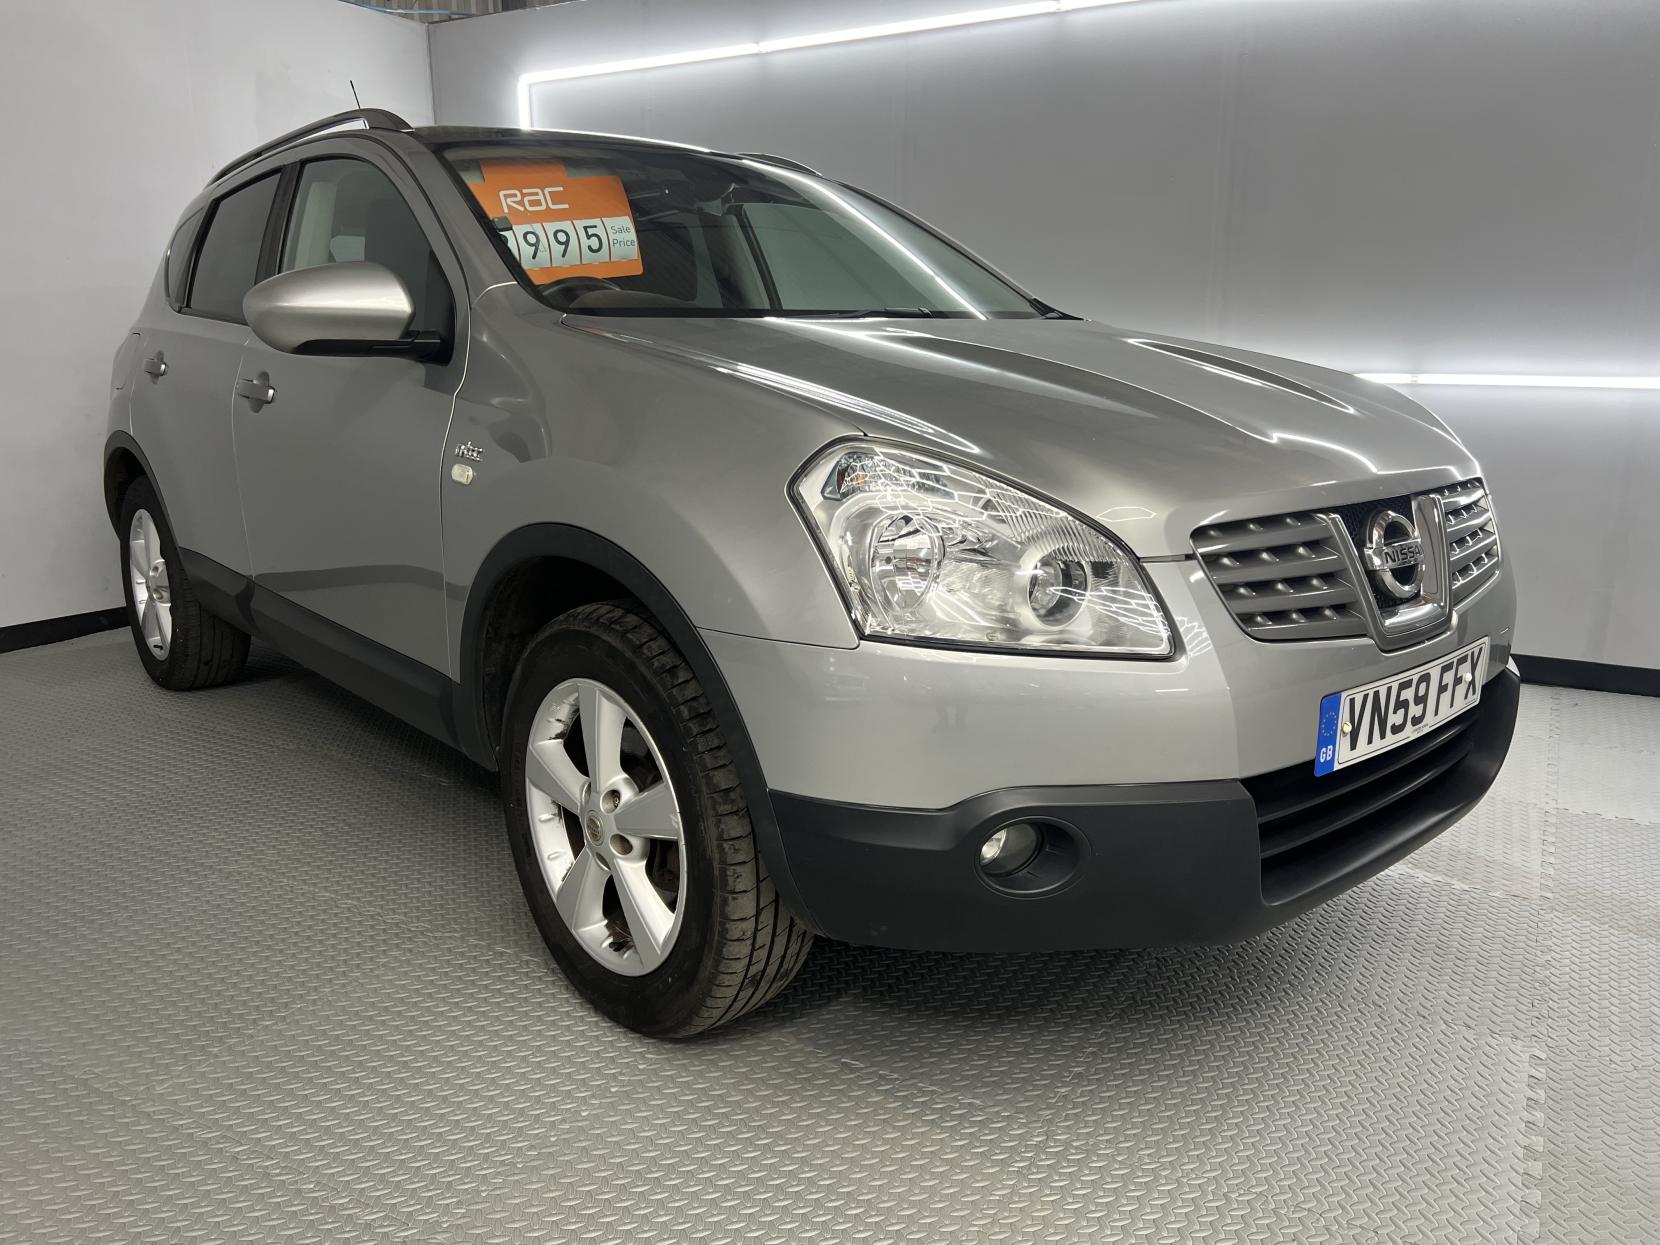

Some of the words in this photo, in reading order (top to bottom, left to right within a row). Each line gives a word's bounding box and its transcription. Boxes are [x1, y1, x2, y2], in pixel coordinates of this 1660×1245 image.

[610, 225, 631, 235] Sale
[612, 238, 636, 248] Price
[1349, 672, 1431, 752] VN59
[1434, 646, 1483, 717] FFX
[1319, 745, 1333, 763] GB
